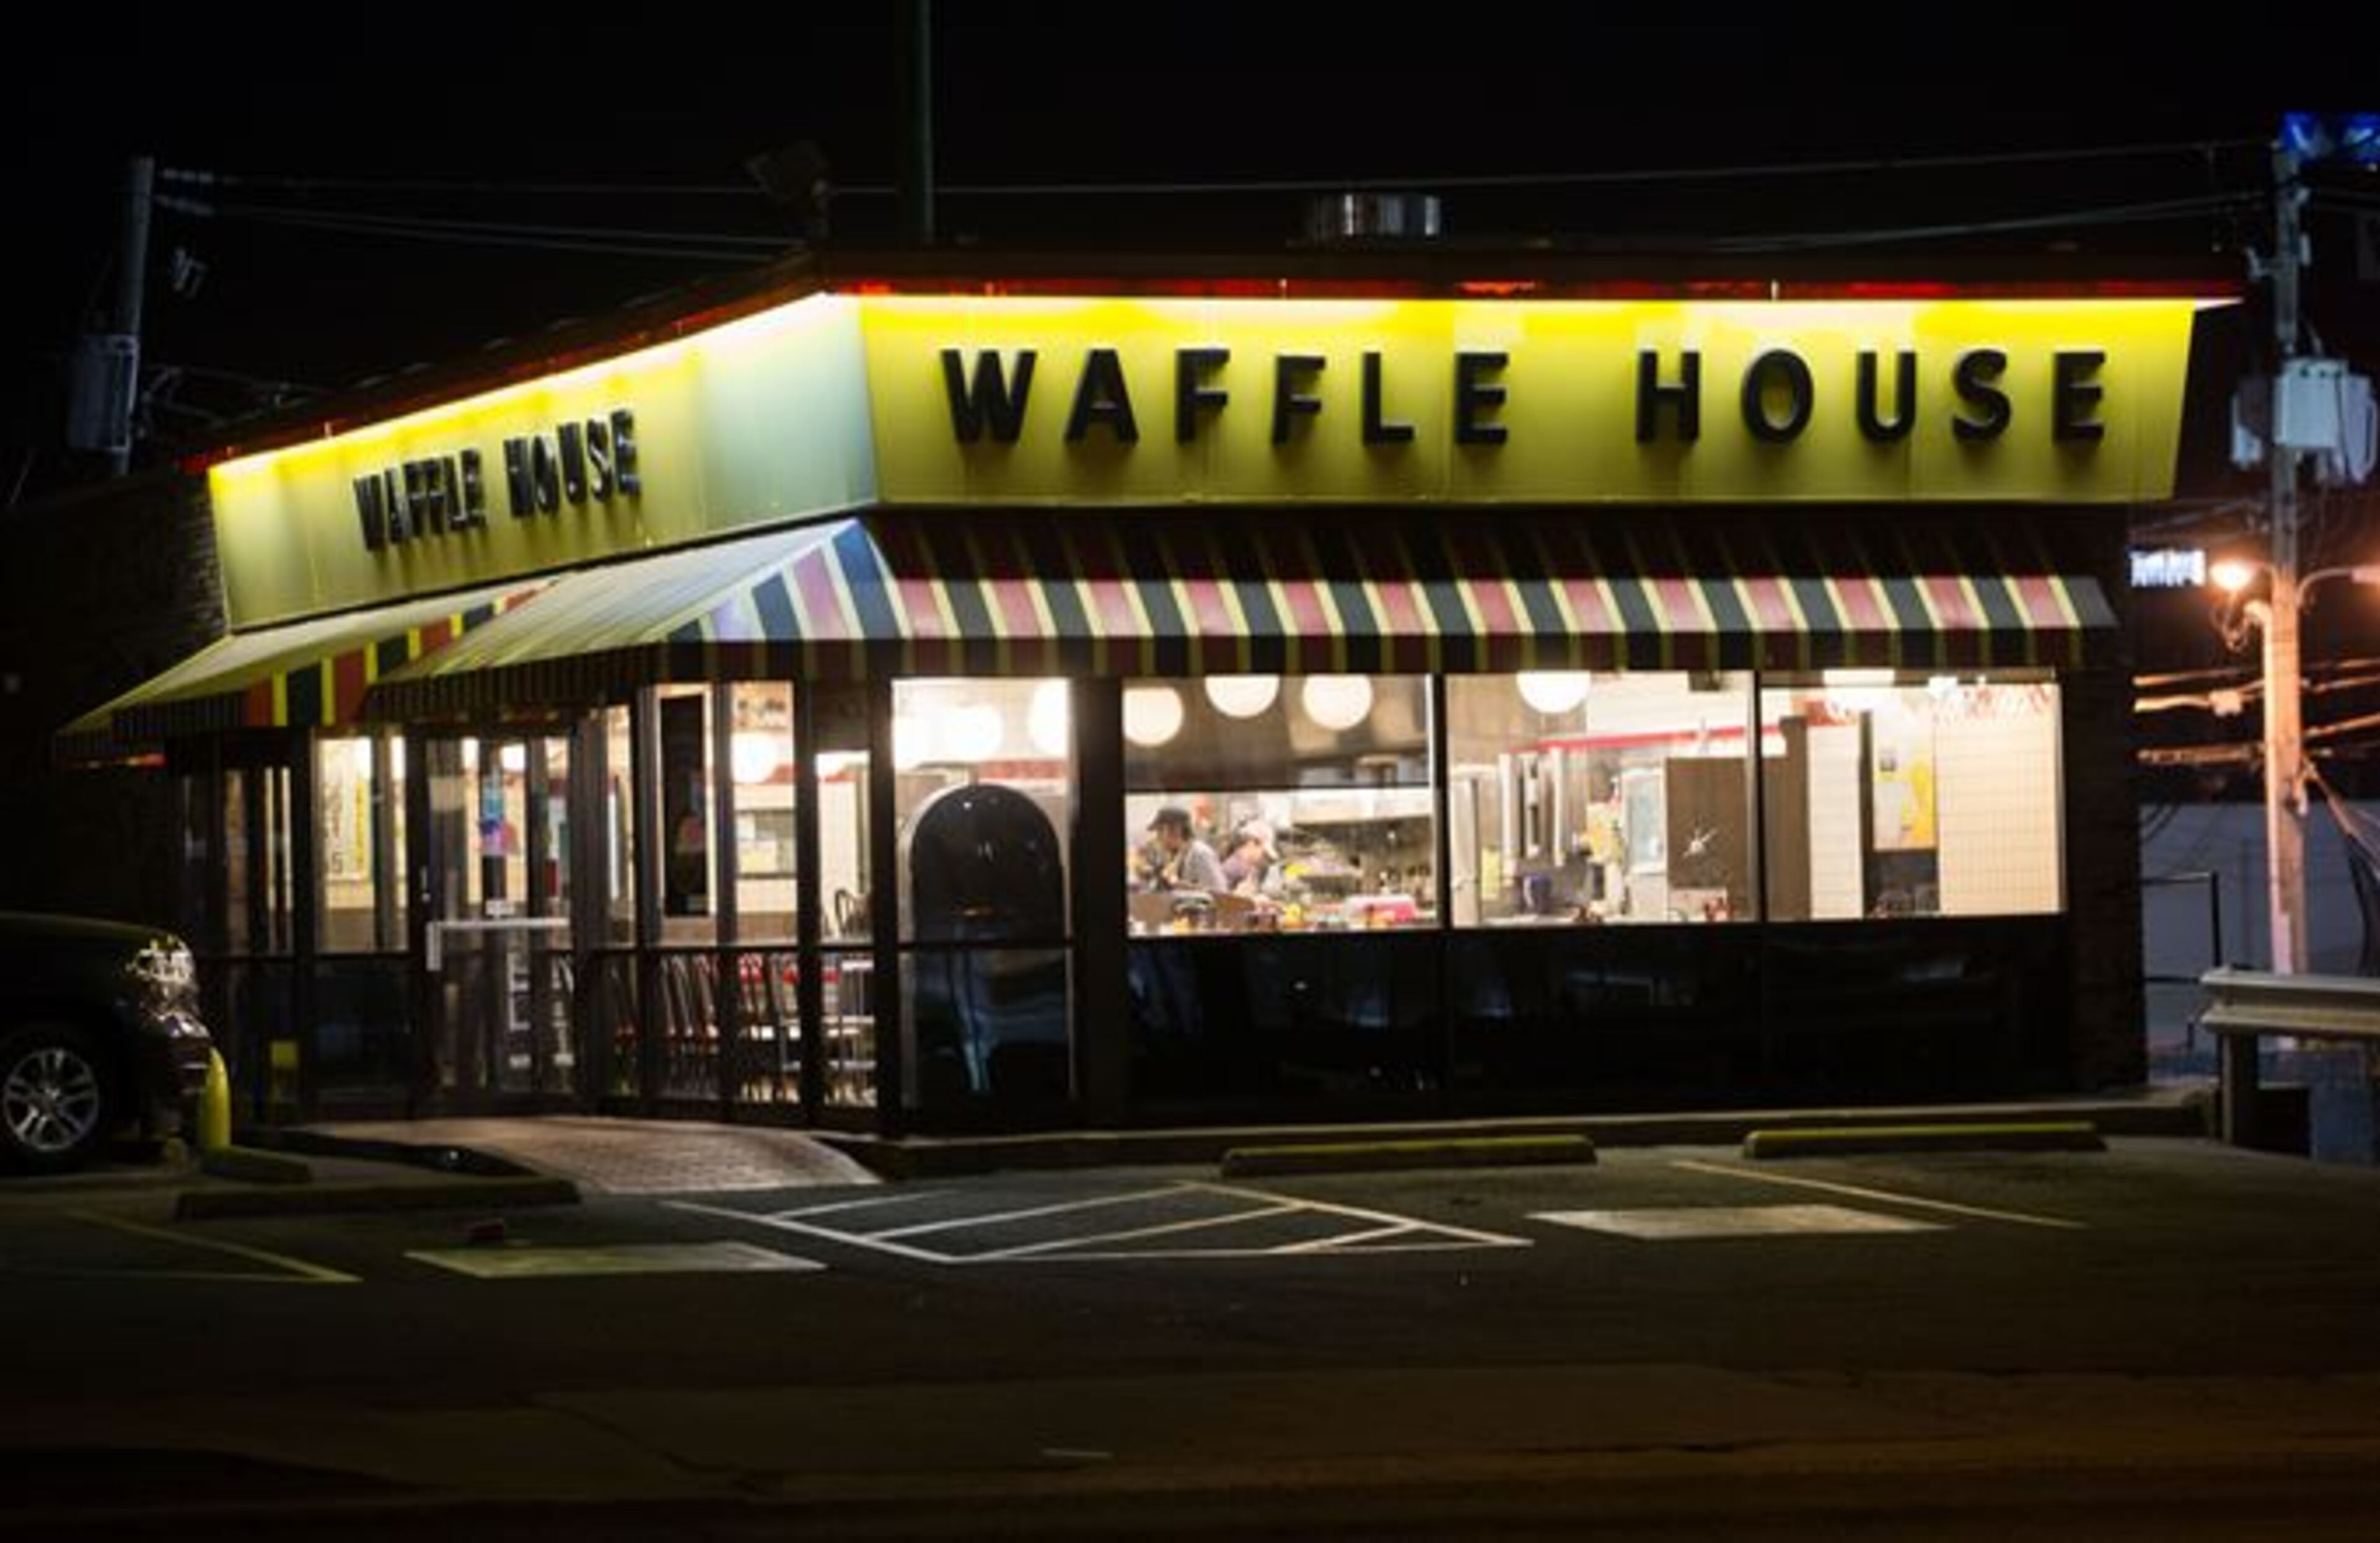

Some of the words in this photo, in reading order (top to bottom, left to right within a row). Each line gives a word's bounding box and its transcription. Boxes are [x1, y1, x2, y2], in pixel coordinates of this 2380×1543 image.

[941, 348, 1510, 445] WAFFLE
[1636, 348, 2106, 444] HOUSE
[353, 449, 487, 550] WAFFLE
[504, 409, 641, 518] HOUSE
